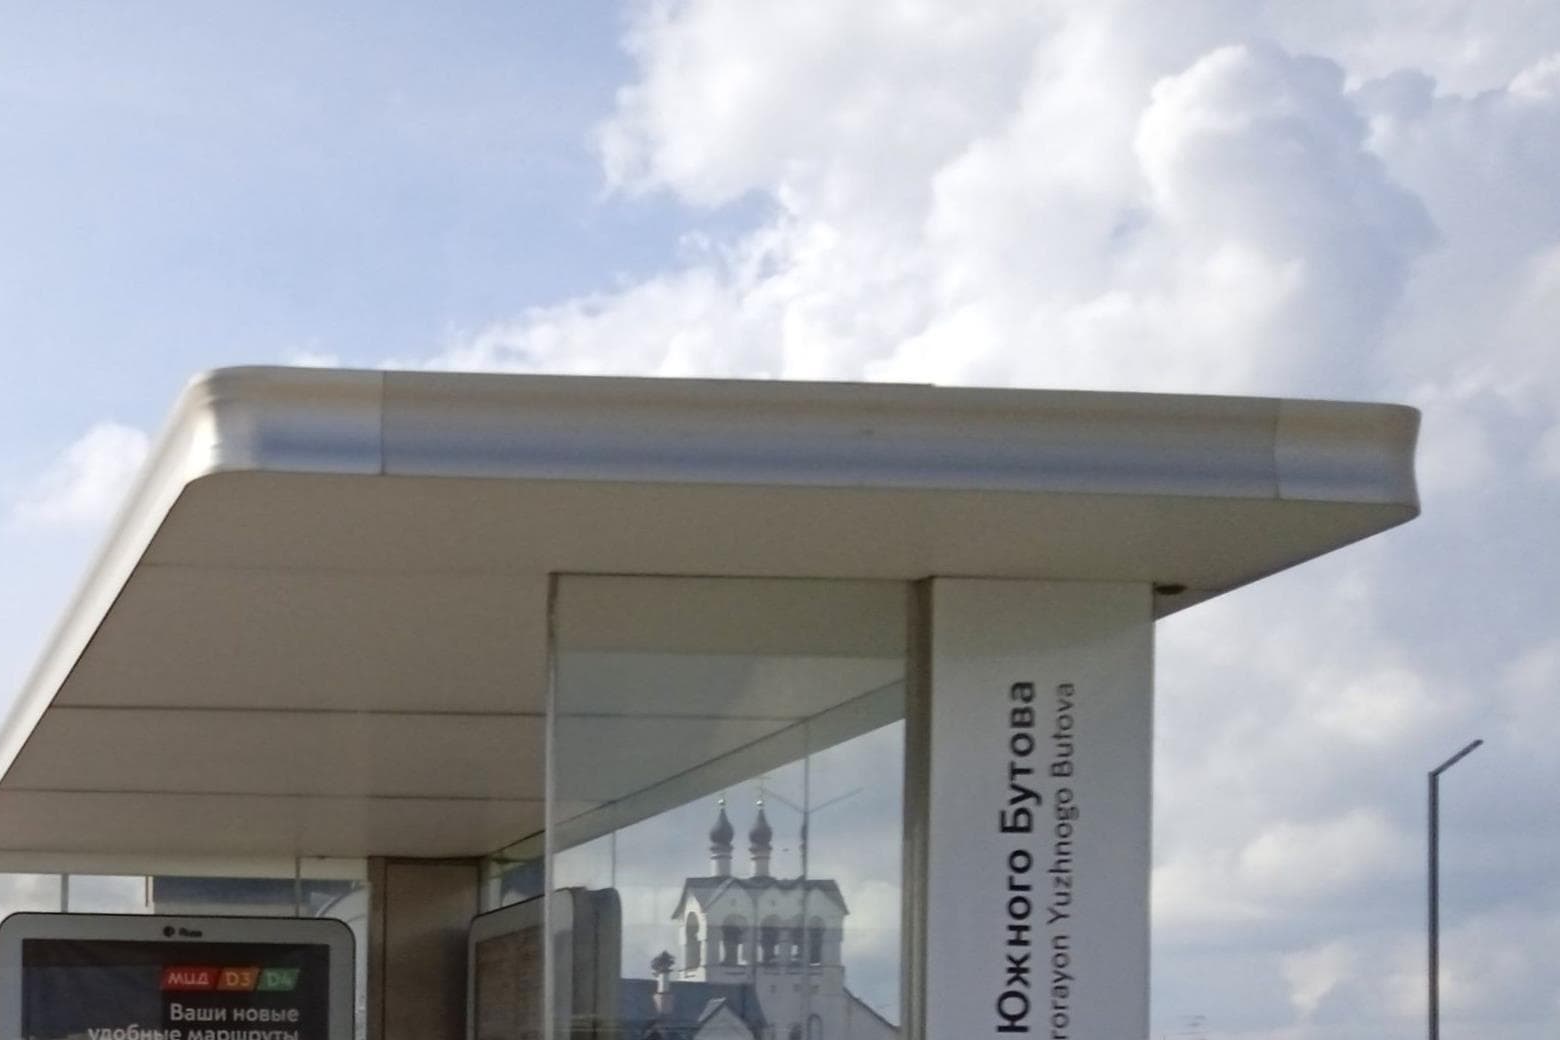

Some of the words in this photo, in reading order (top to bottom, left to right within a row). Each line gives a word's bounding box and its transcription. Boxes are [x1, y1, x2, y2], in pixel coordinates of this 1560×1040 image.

[998, 681, 1043, 835] Бутова
[1048, 682, 1075, 778] Butova
[1045, 787, 1080, 925] Yuzhnogo
[167, 972, 210, 985] МЦД
[225, 972, 251, 987] D3
[266, 972, 293, 988] D4
[994, 848, 1035, 1034] Южного
[169, 1002, 228, 1022] Ваши
[233, 1008, 300, 1023] новые
